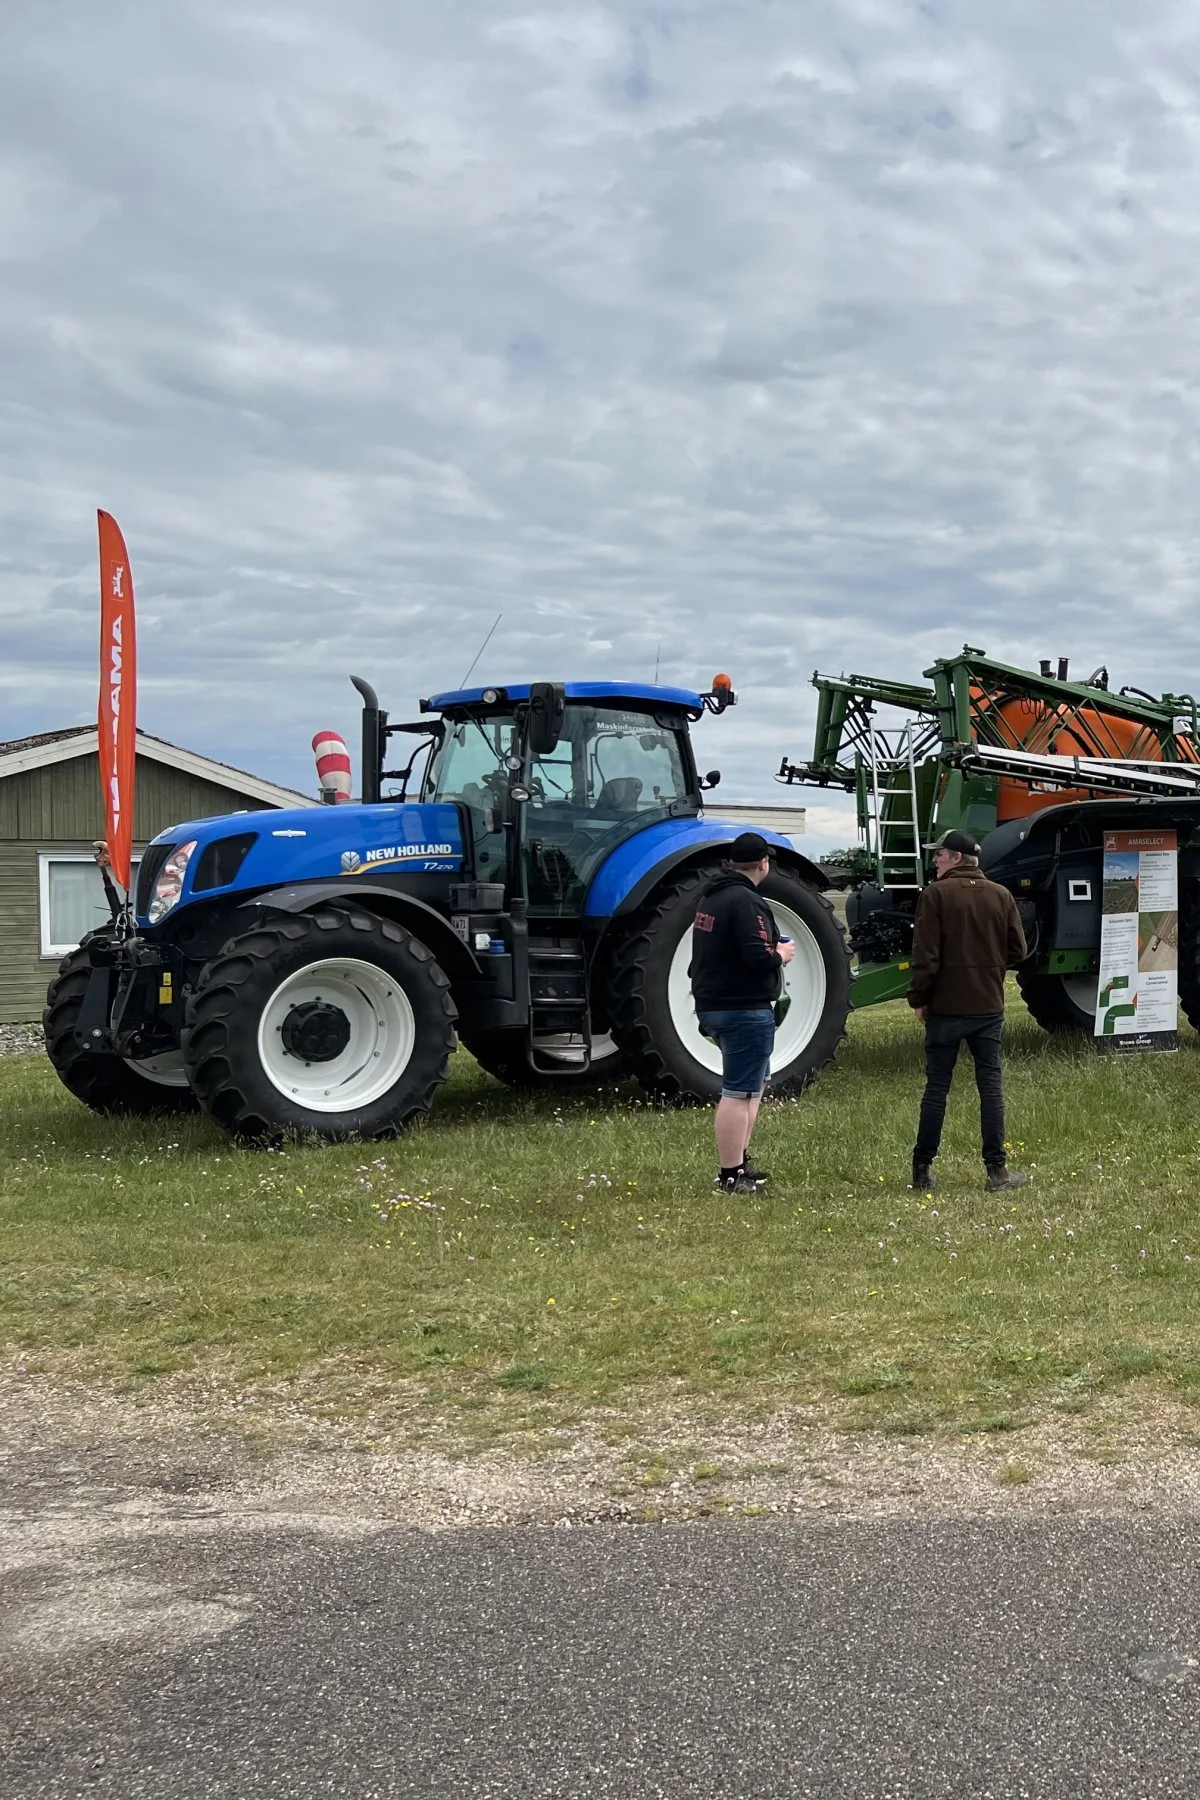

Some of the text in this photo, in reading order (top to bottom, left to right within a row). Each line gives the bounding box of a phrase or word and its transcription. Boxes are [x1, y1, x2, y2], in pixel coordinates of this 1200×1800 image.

[1128, 837, 1164, 846] AMASELECT
[366, 843, 452, 862] NEW HOLLAND
